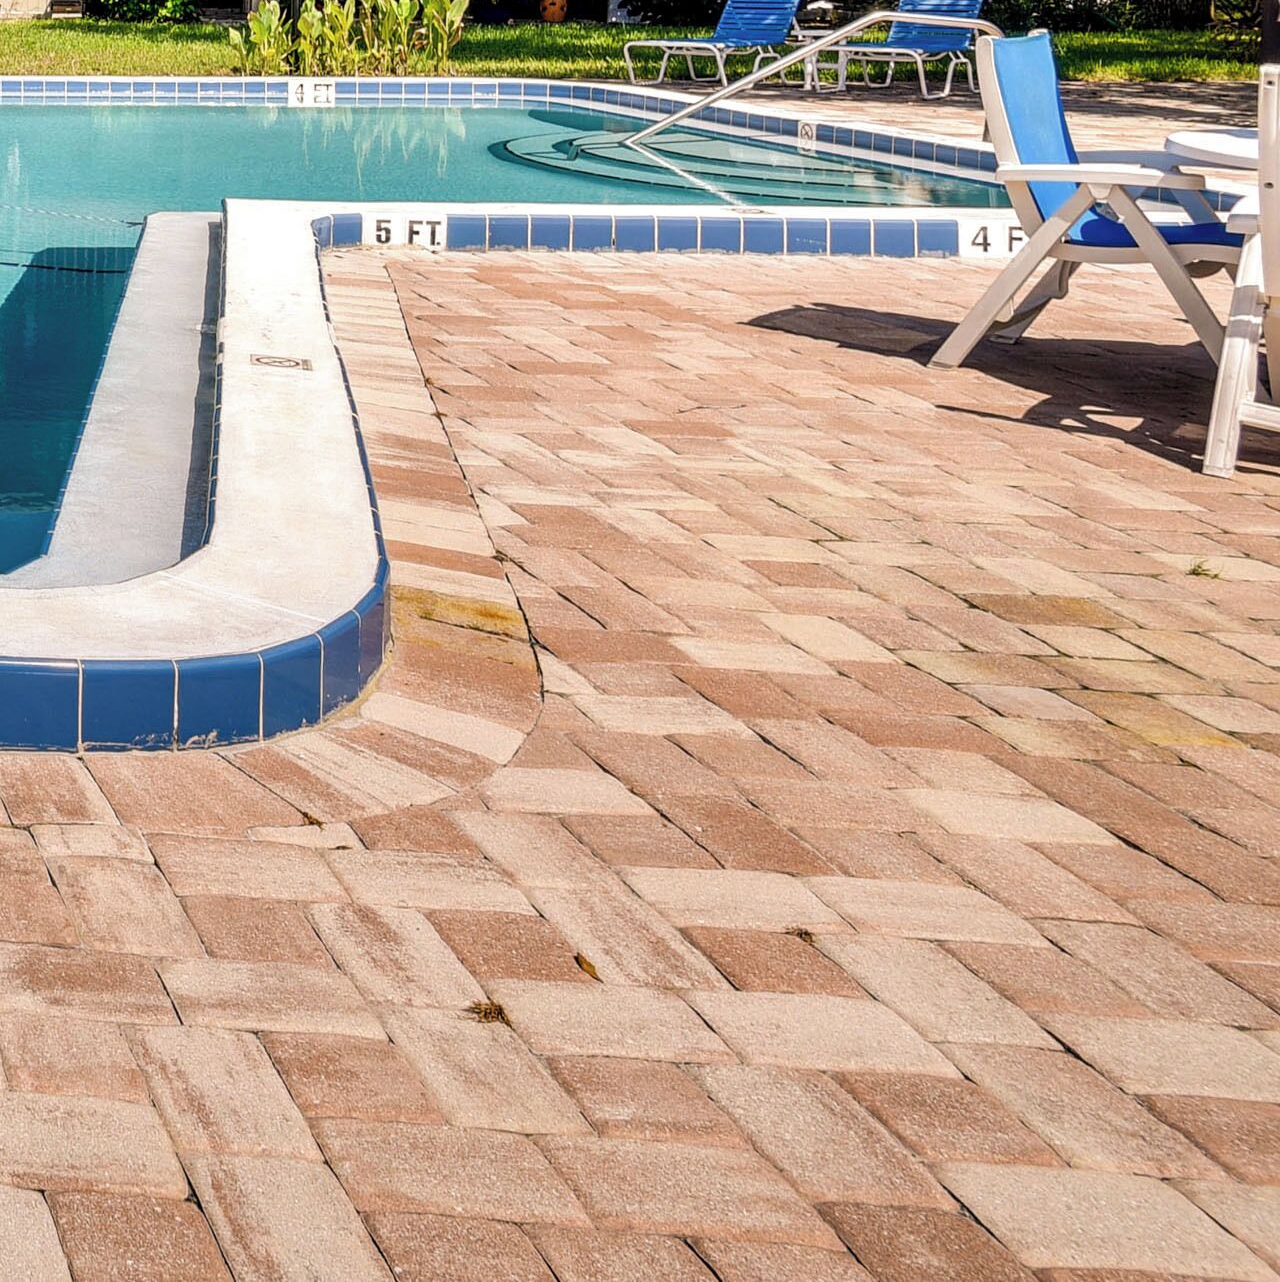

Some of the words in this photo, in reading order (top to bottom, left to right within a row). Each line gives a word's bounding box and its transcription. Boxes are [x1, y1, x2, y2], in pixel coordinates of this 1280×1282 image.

[375, 219, 391, 244] 5
[408, 220, 442, 246] FT.
[971, 226, 991, 252] 4
[1008, 226, 1023, 252] F
